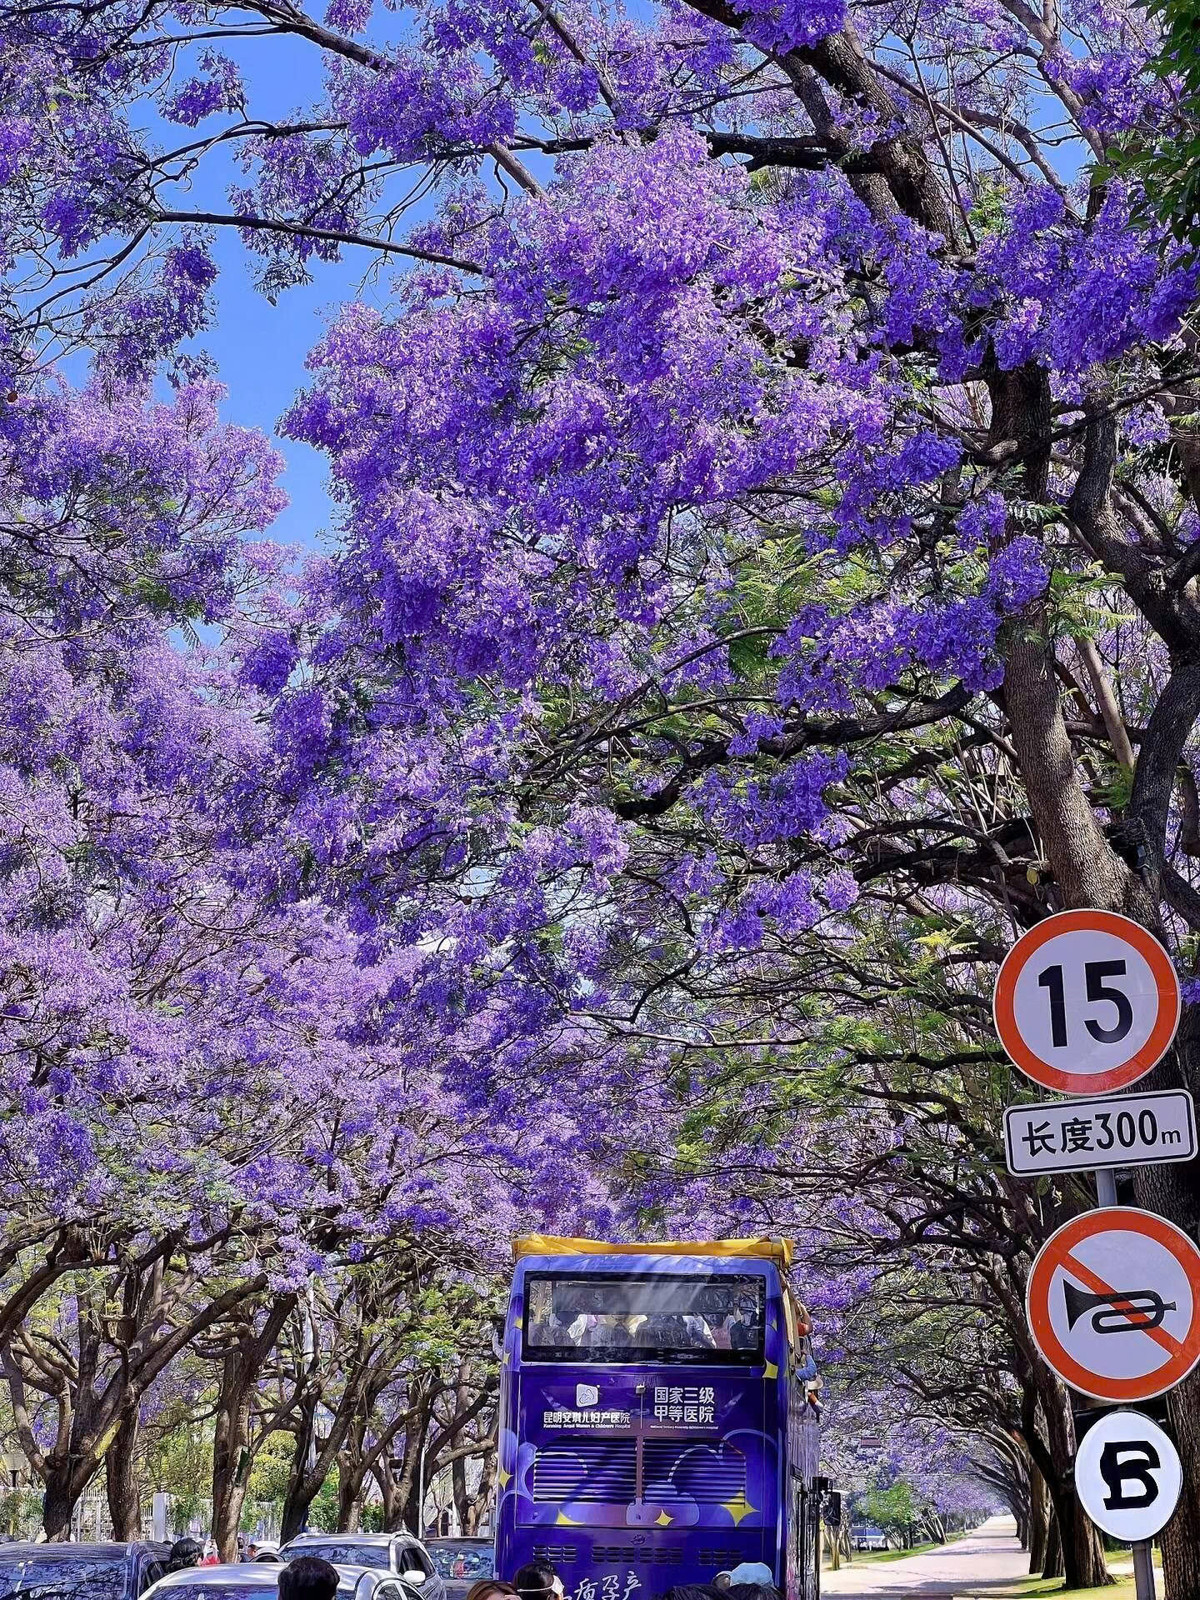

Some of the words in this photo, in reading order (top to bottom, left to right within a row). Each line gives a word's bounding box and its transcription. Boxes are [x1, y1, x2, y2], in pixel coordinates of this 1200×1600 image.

[1037, 959, 1134, 1048] 15
[1021, 1109, 1182, 1157] 长度300m
[654, 1386, 715, 1404] 国家三级
[654, 1405, 715, 1423] 甲等医院
